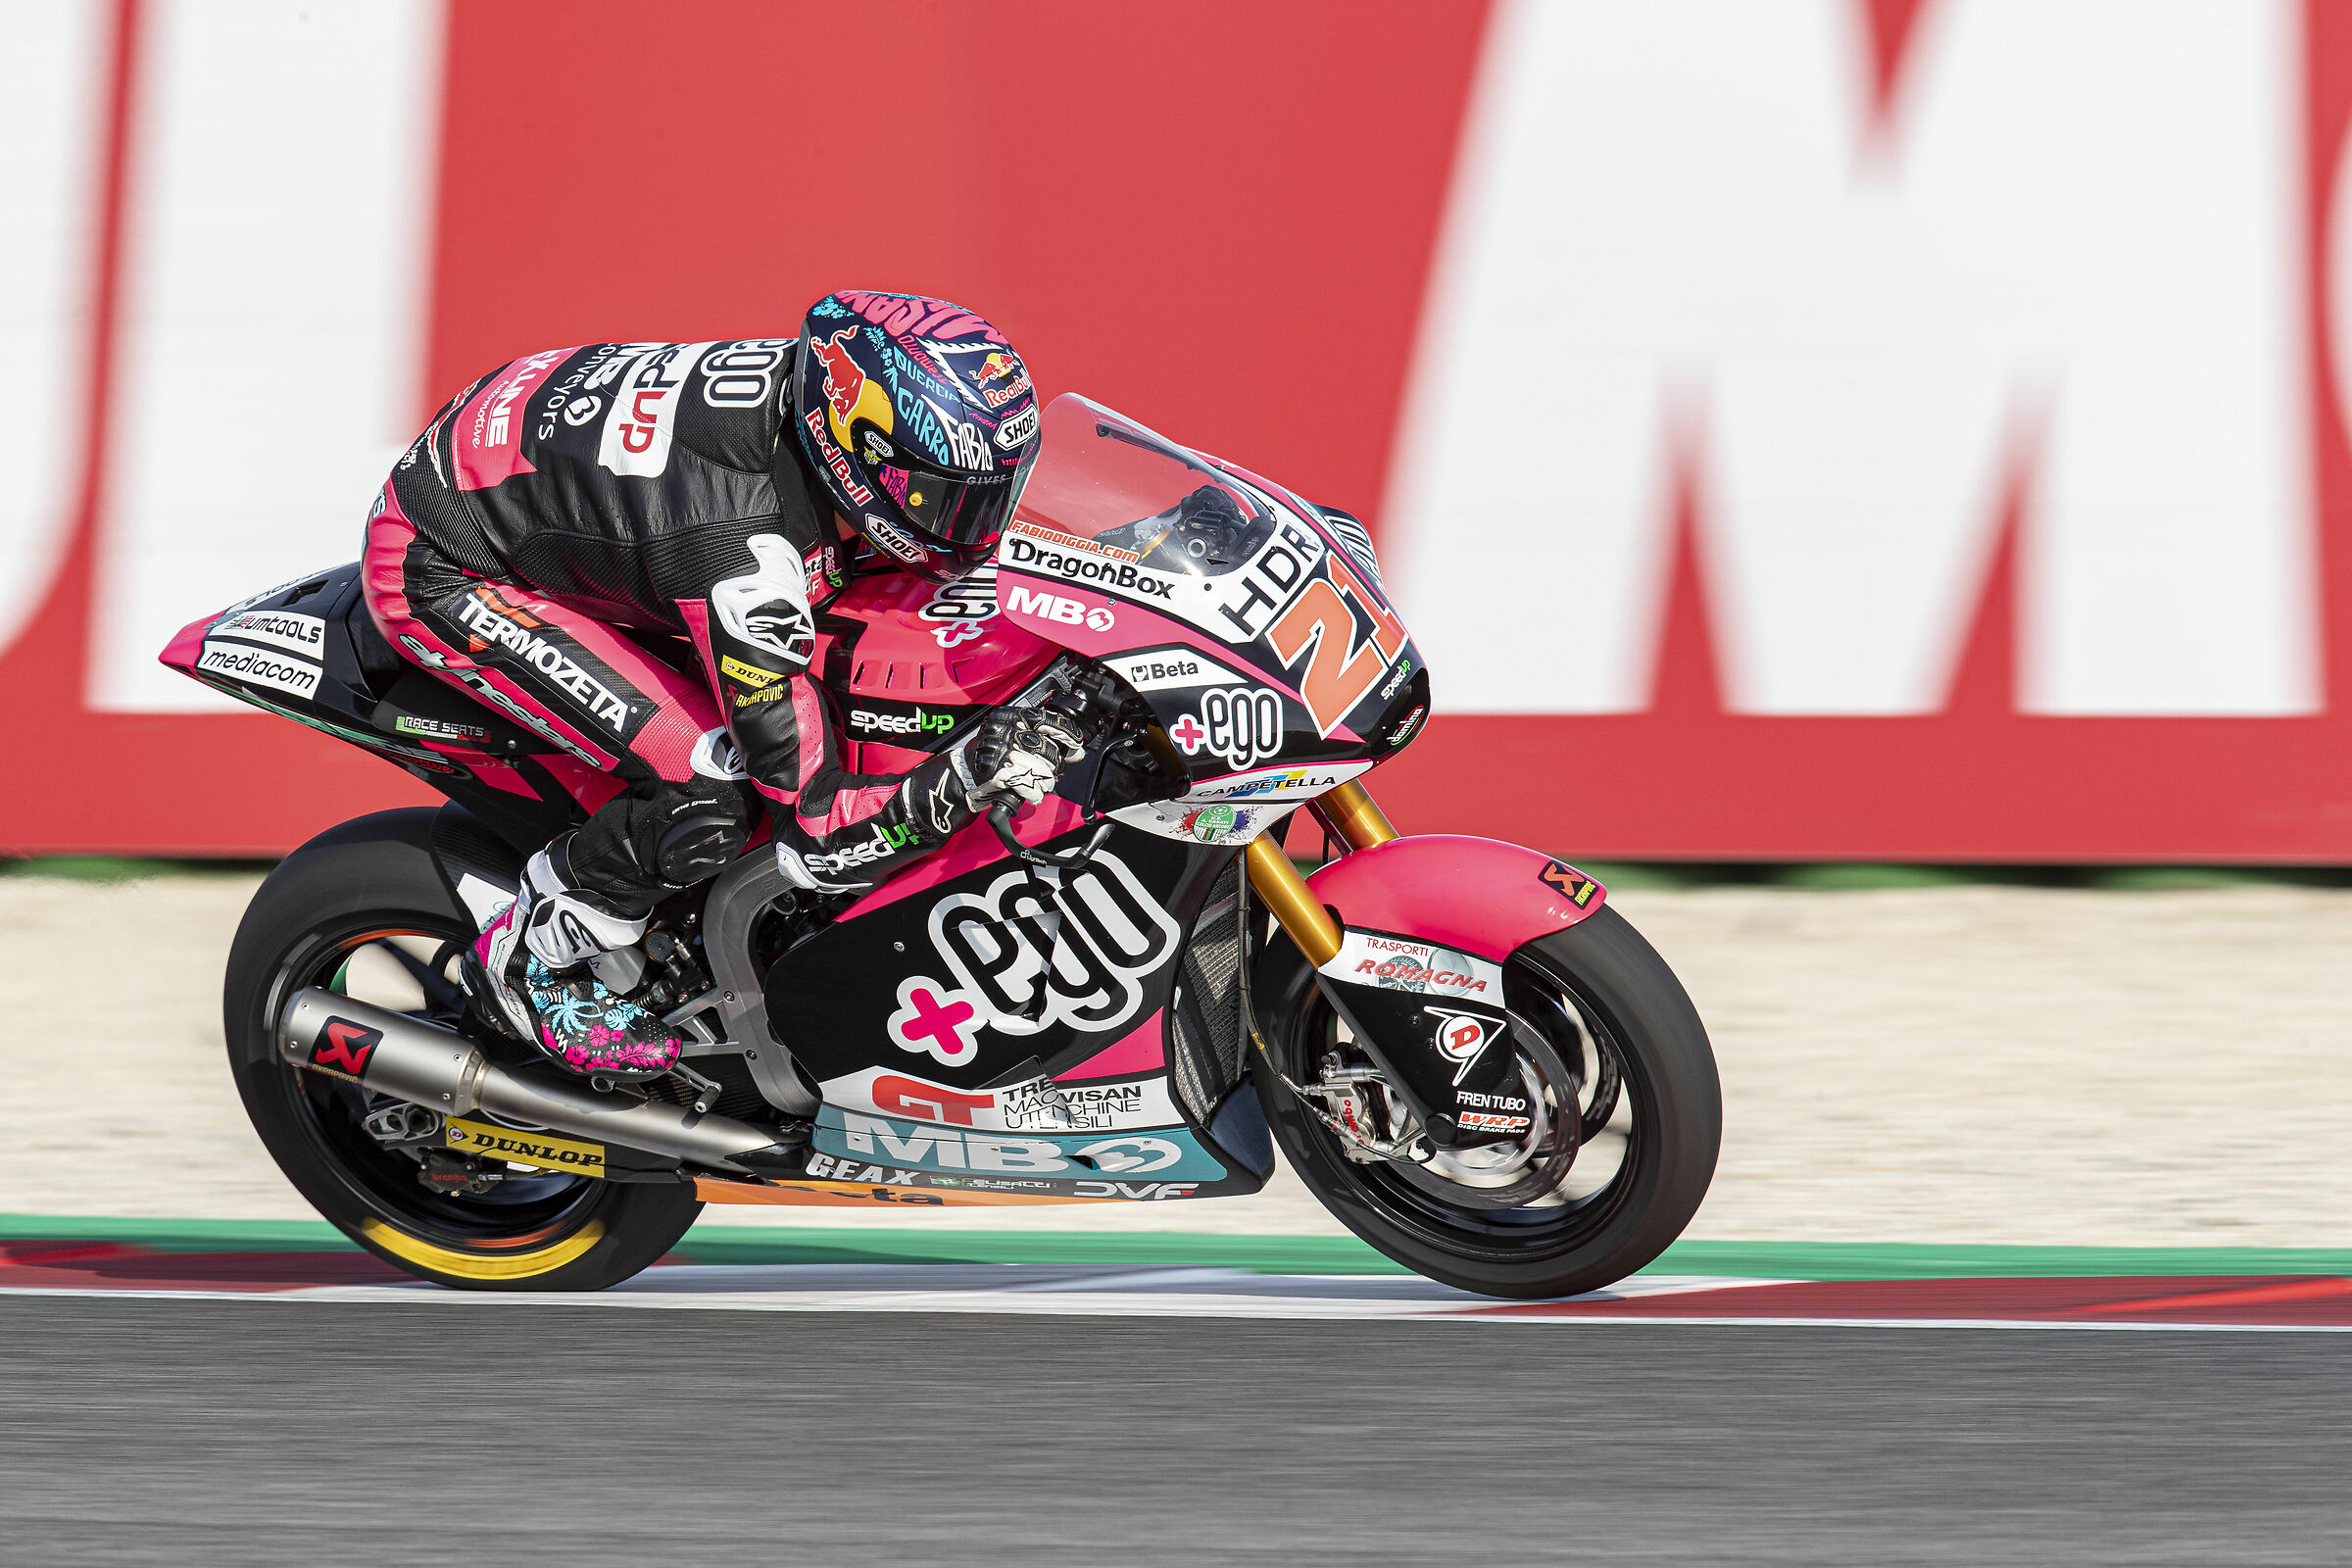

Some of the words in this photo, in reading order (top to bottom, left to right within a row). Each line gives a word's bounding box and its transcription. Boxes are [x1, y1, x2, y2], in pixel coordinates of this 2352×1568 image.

[539, 343, 616, 440] onveyors
[983, 381, 1017, 408] Red
[866, 432, 892, 456] SHOEI
[1005, 411, 1037, 444] SHOEI
[806, 407, 843, 465] Red
[830, 454, 874, 508] Bull
[871, 521, 921, 560] SHOEI
[1008, 537, 1176, 601] DragonBox
[1218, 523, 1320, 637] HDR
[1264, 548, 1410, 741] 21
[203, 649, 317, 691] mediacom
[458, 593, 629, 733] TERMOZETA
[736, 667, 775, 684] DUNL
[1151, 660, 1200, 680] Beta
[405, 716, 439, 732] RACE
[442, 721, 485, 737] SEATS
[1196, 776, 1337, 798] CAMPETELLA
[1366, 937, 1429, 956] TRASPORTI
[1354, 958, 1489, 994] ROMAGNA
[872, 1075, 995, 1126] GT
[1456, 1090, 1492, 1108] FREN
[1492, 1095, 1526, 1111] TUBO
[1459, 1111, 1531, 1129] WRP
[472, 1132, 603, 1167] DUNLOP
[805, 1152, 920, 1186] GEAX
[1073, 1181, 1200, 1200] DVF
